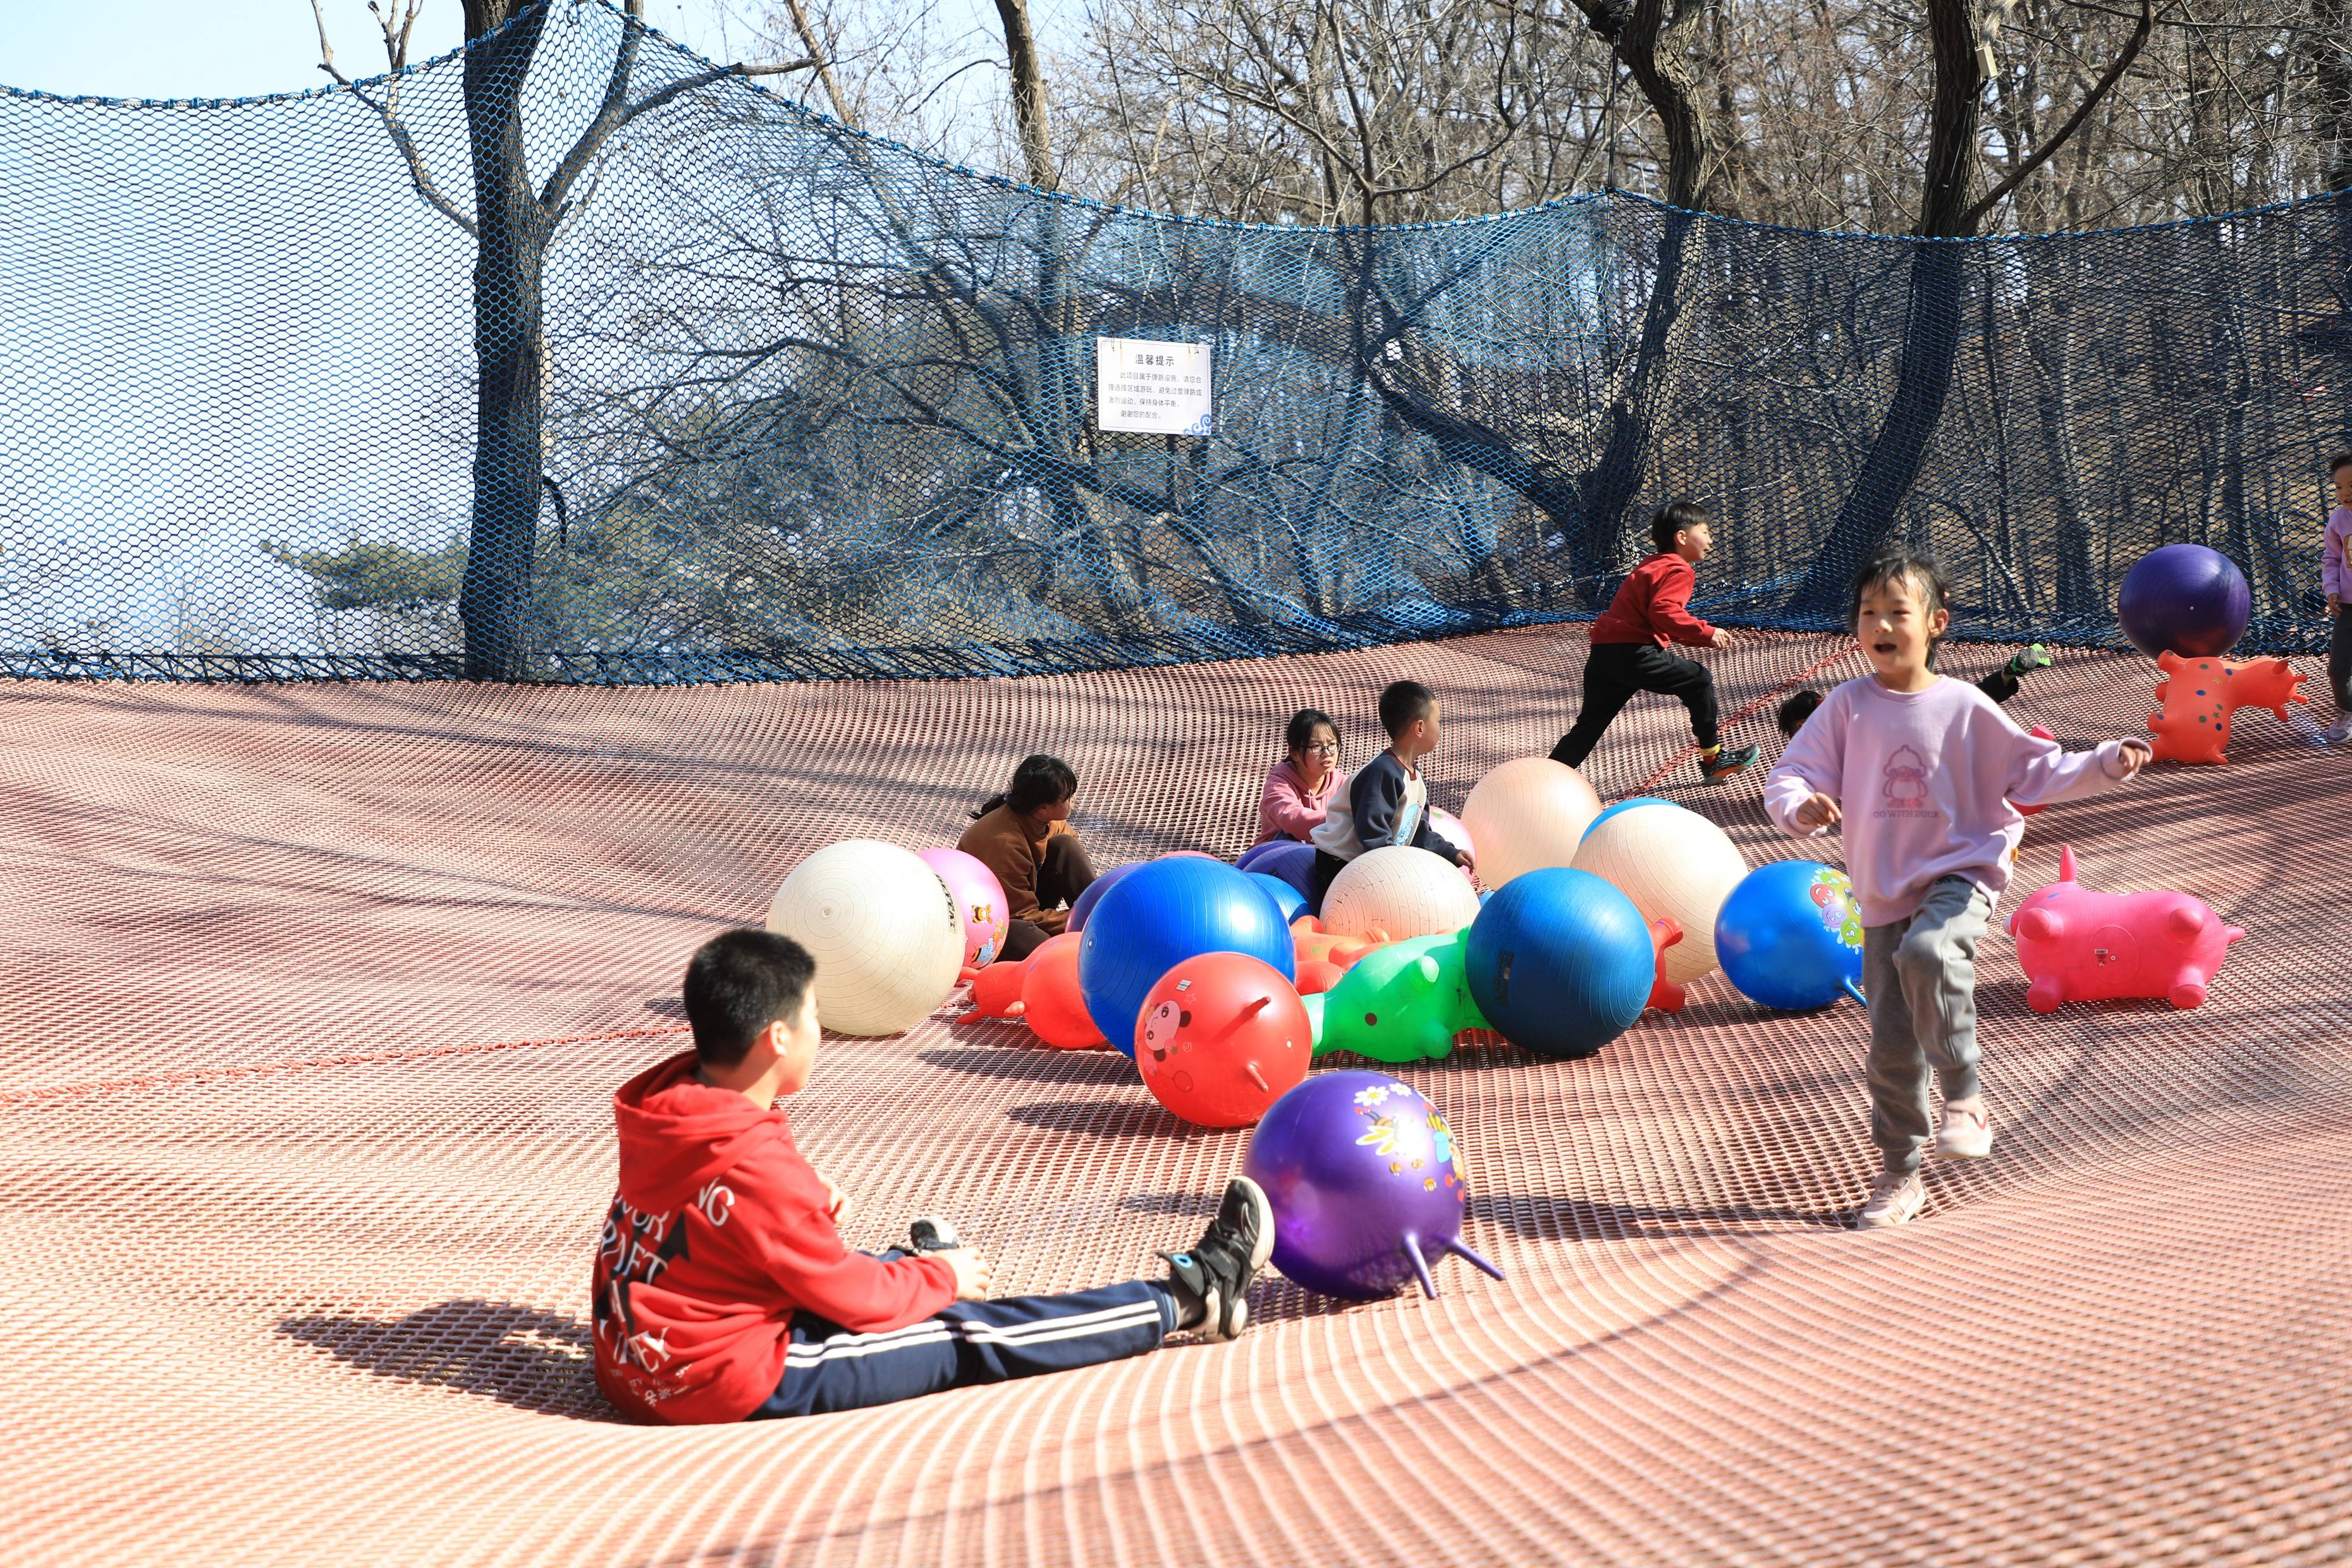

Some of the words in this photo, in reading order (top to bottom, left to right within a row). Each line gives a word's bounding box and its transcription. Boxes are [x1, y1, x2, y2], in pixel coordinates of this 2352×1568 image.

[1135, 354, 1174, 366] 温馨提示
[1873, 810, 1886, 819] GO
[1887, 810, 1913, 819] WITH
[1914, 810, 1940, 819] DUCK
